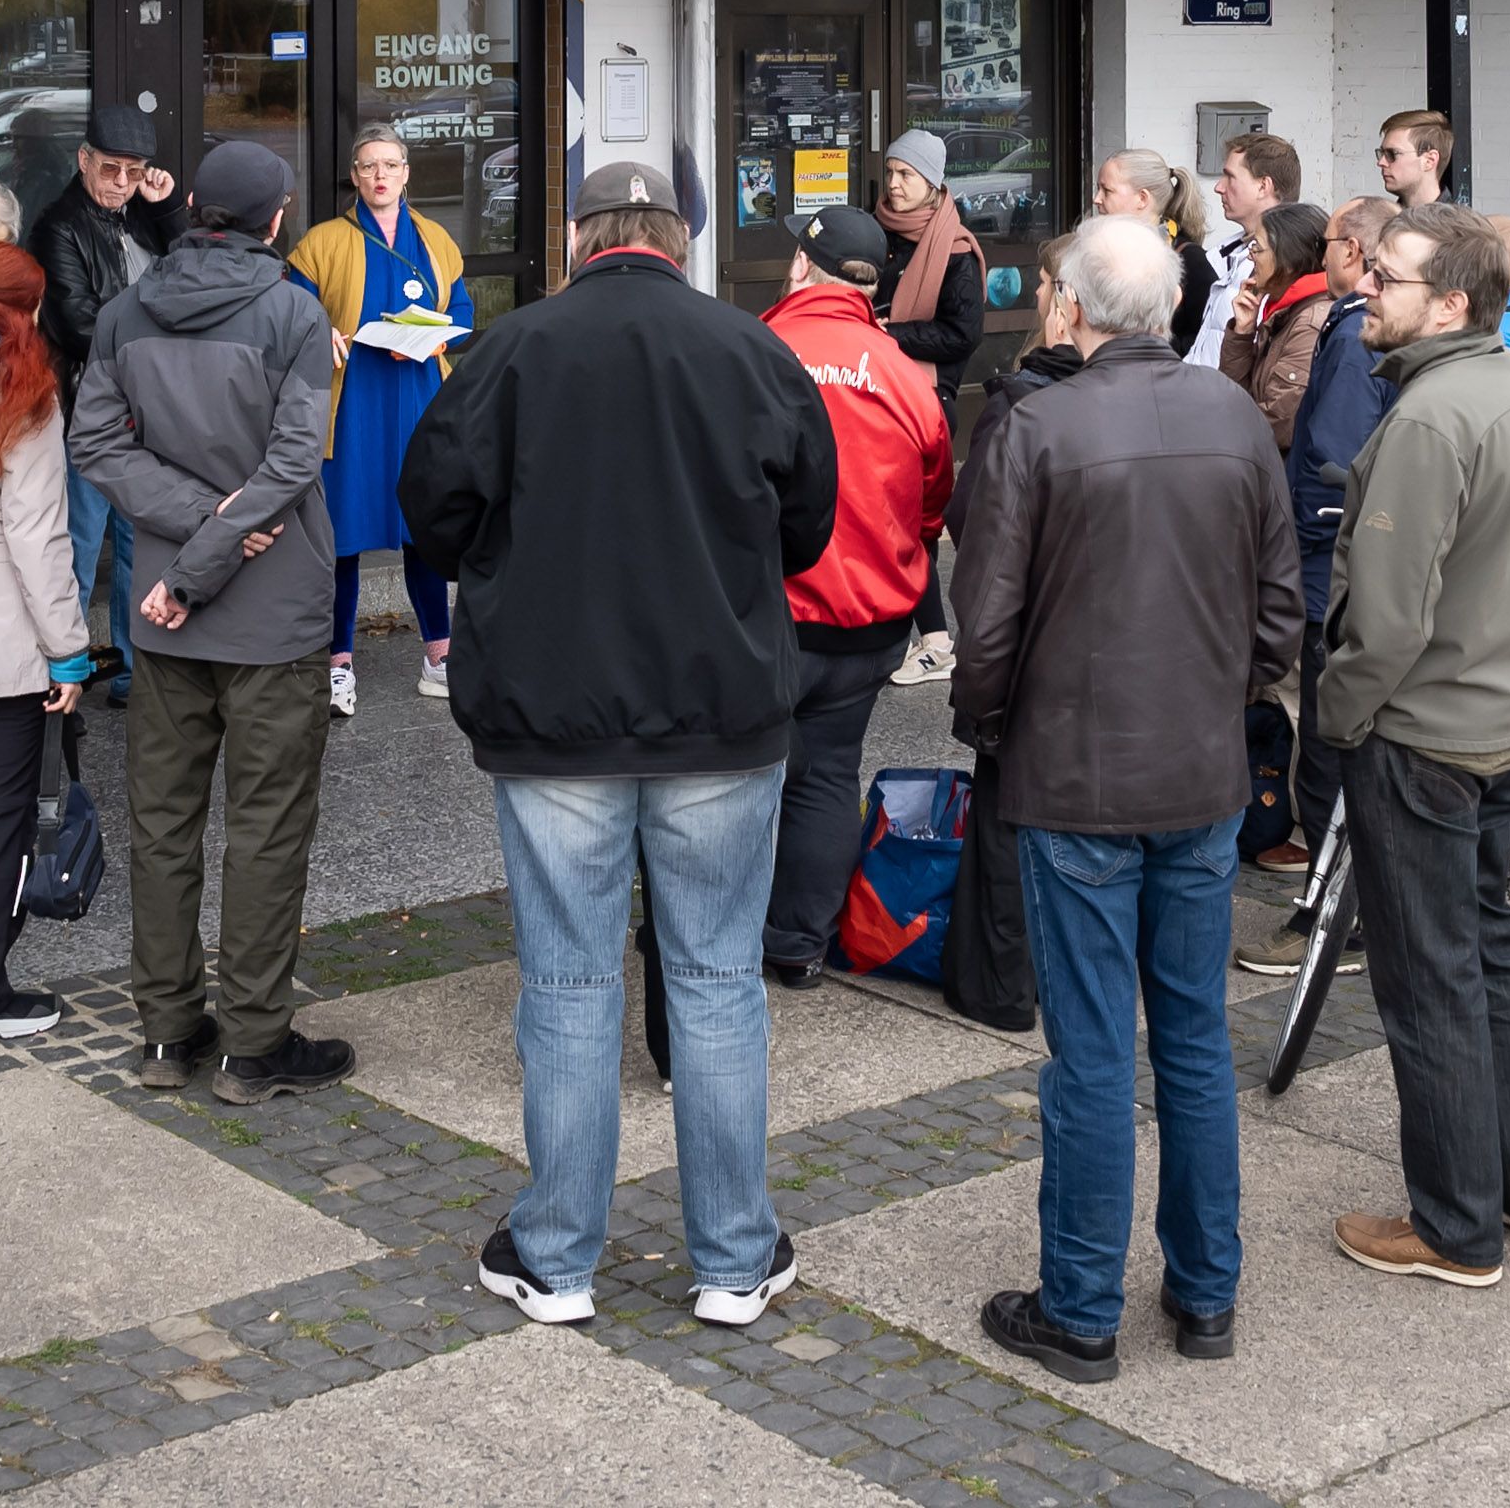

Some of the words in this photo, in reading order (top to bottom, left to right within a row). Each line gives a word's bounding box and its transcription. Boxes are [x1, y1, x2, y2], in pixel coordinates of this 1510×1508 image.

[1216, 1, 1240, 20] Ring
[375, 33, 491, 57] EINGANG
[375, 64, 492, 89] BOWLING
[393, 115, 495, 140] ASERTAG
